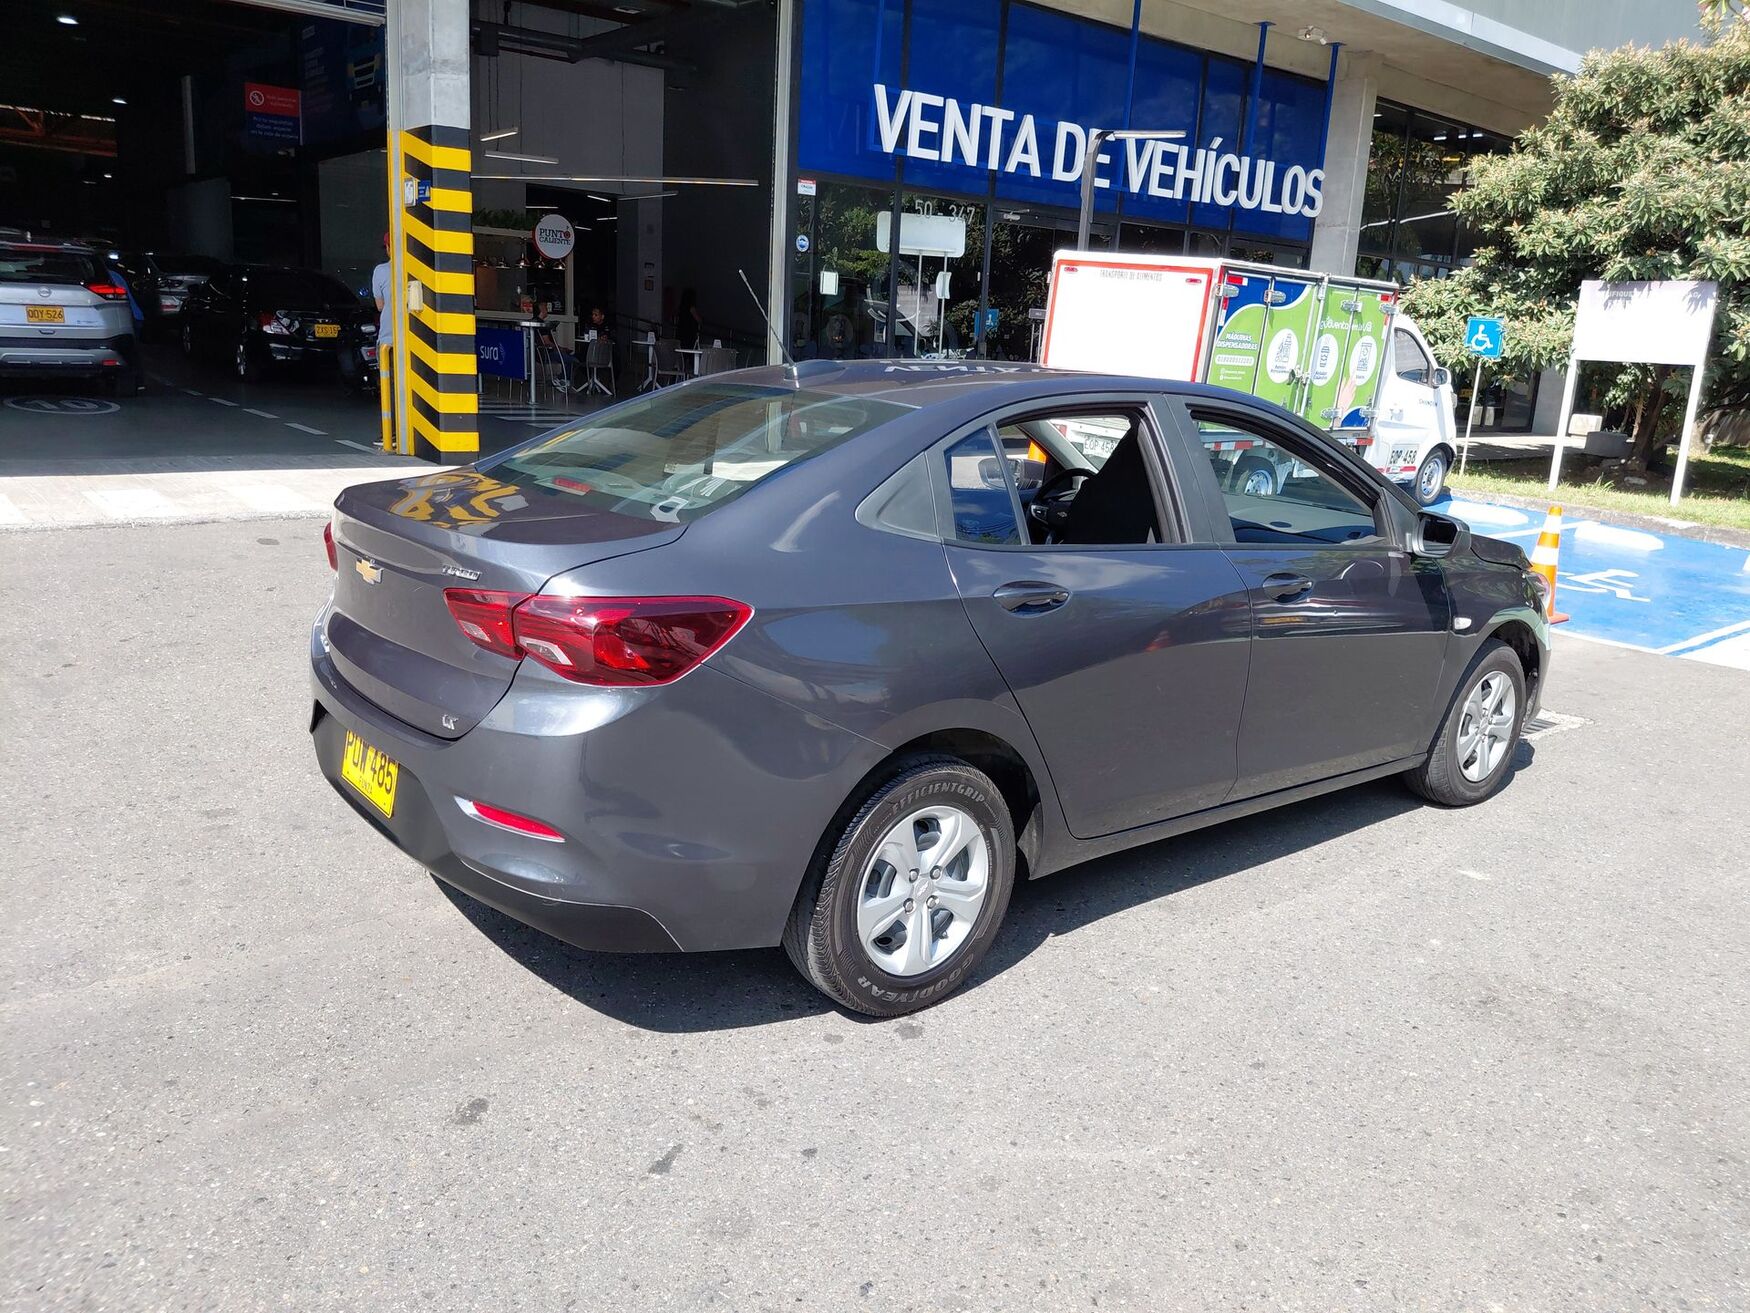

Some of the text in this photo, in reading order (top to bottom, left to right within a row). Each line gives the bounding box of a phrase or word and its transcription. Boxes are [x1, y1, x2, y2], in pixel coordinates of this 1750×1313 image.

[873, 83, 1327, 219] VENTA DE VEHÍCULOS
[915, 199, 933, 219] 50
[948, 204, 976, 225] 347
[539, 227, 571, 239] PUNTO
[539, 237, 571, 246] CALIENTE
[46, 309, 64, 319] 526
[479, 345, 499, 361] sura
[1403, 449, 1417, 464] 458
[370, 747, 394, 795] 485
[891, 782, 985, 815] EFFICIENTGRIP
[857, 953, 974, 1003] GOODYEAR
